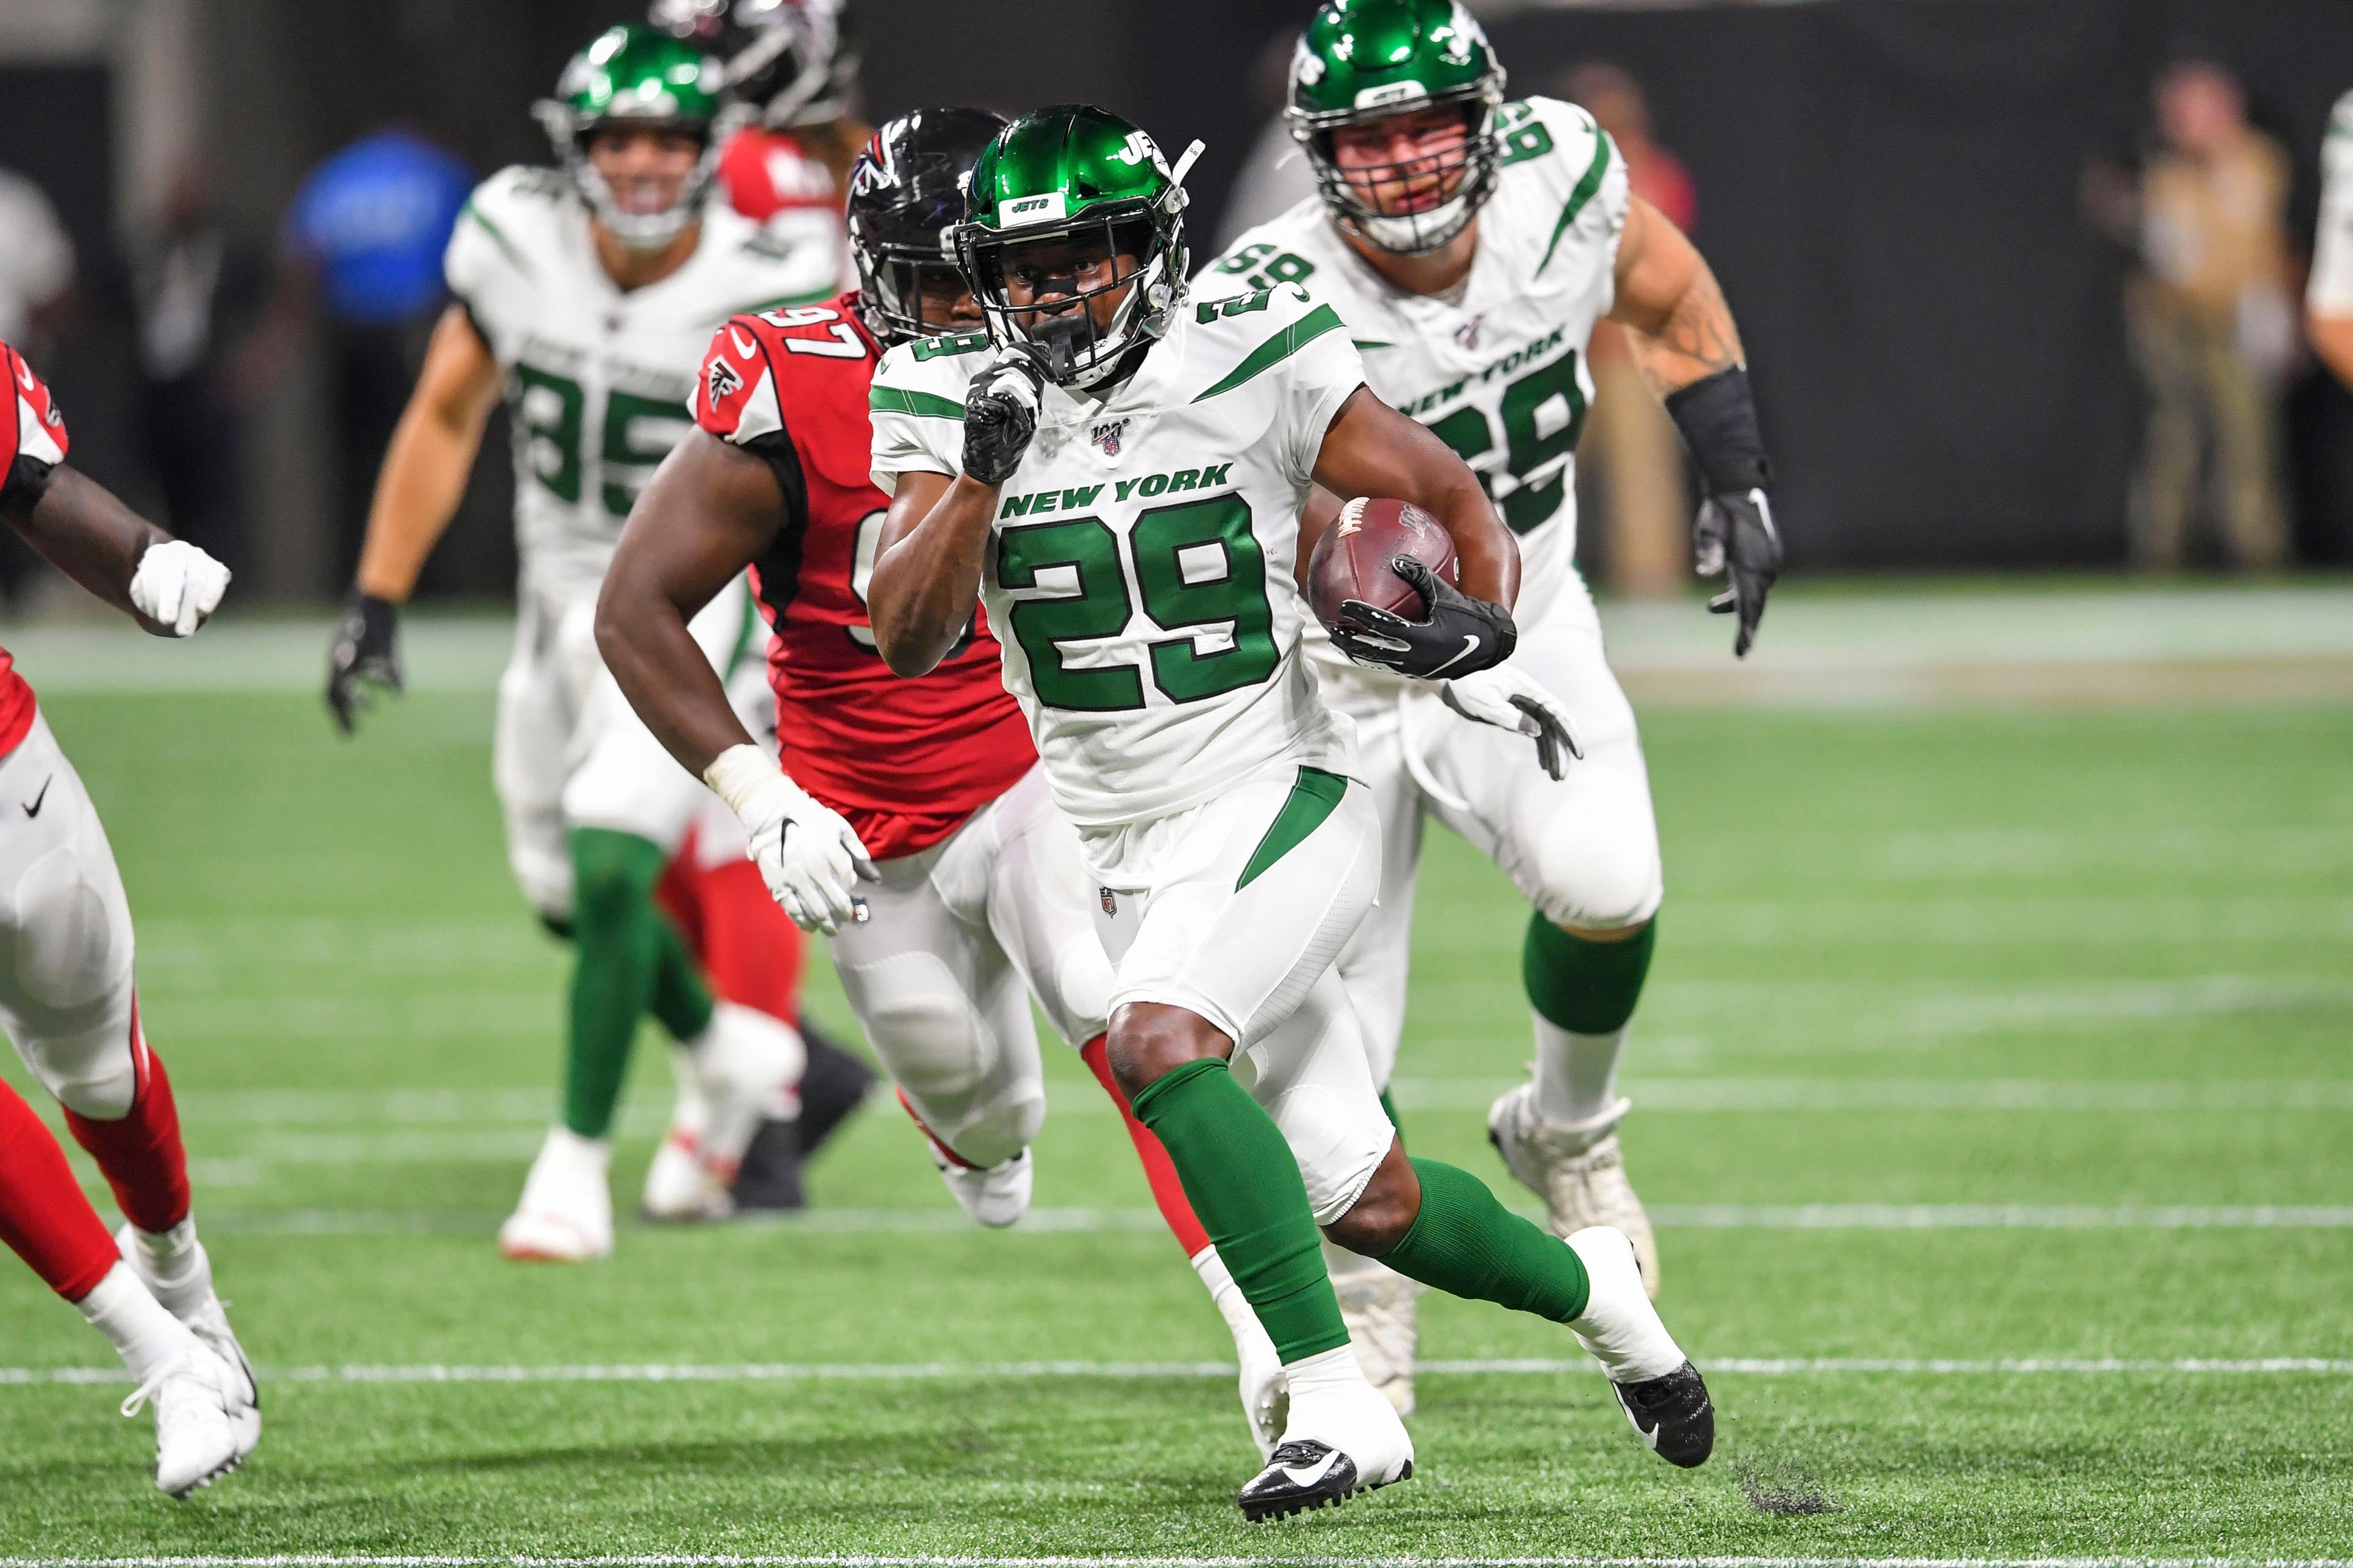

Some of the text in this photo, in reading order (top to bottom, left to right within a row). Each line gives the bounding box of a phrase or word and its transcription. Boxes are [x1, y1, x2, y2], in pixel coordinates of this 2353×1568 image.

[1012, 199, 1049, 213] JETS
[1212, 243, 1316, 292] 69
[756, 306, 867, 360] 97
[1195, 290, 1273, 325] 2
[909, 326, 991, 362] 9
[1482, 322, 1567, 384] YORK
[999, 462, 1234, 520] NEW YORK
[996, 492, 1281, 712] 29
